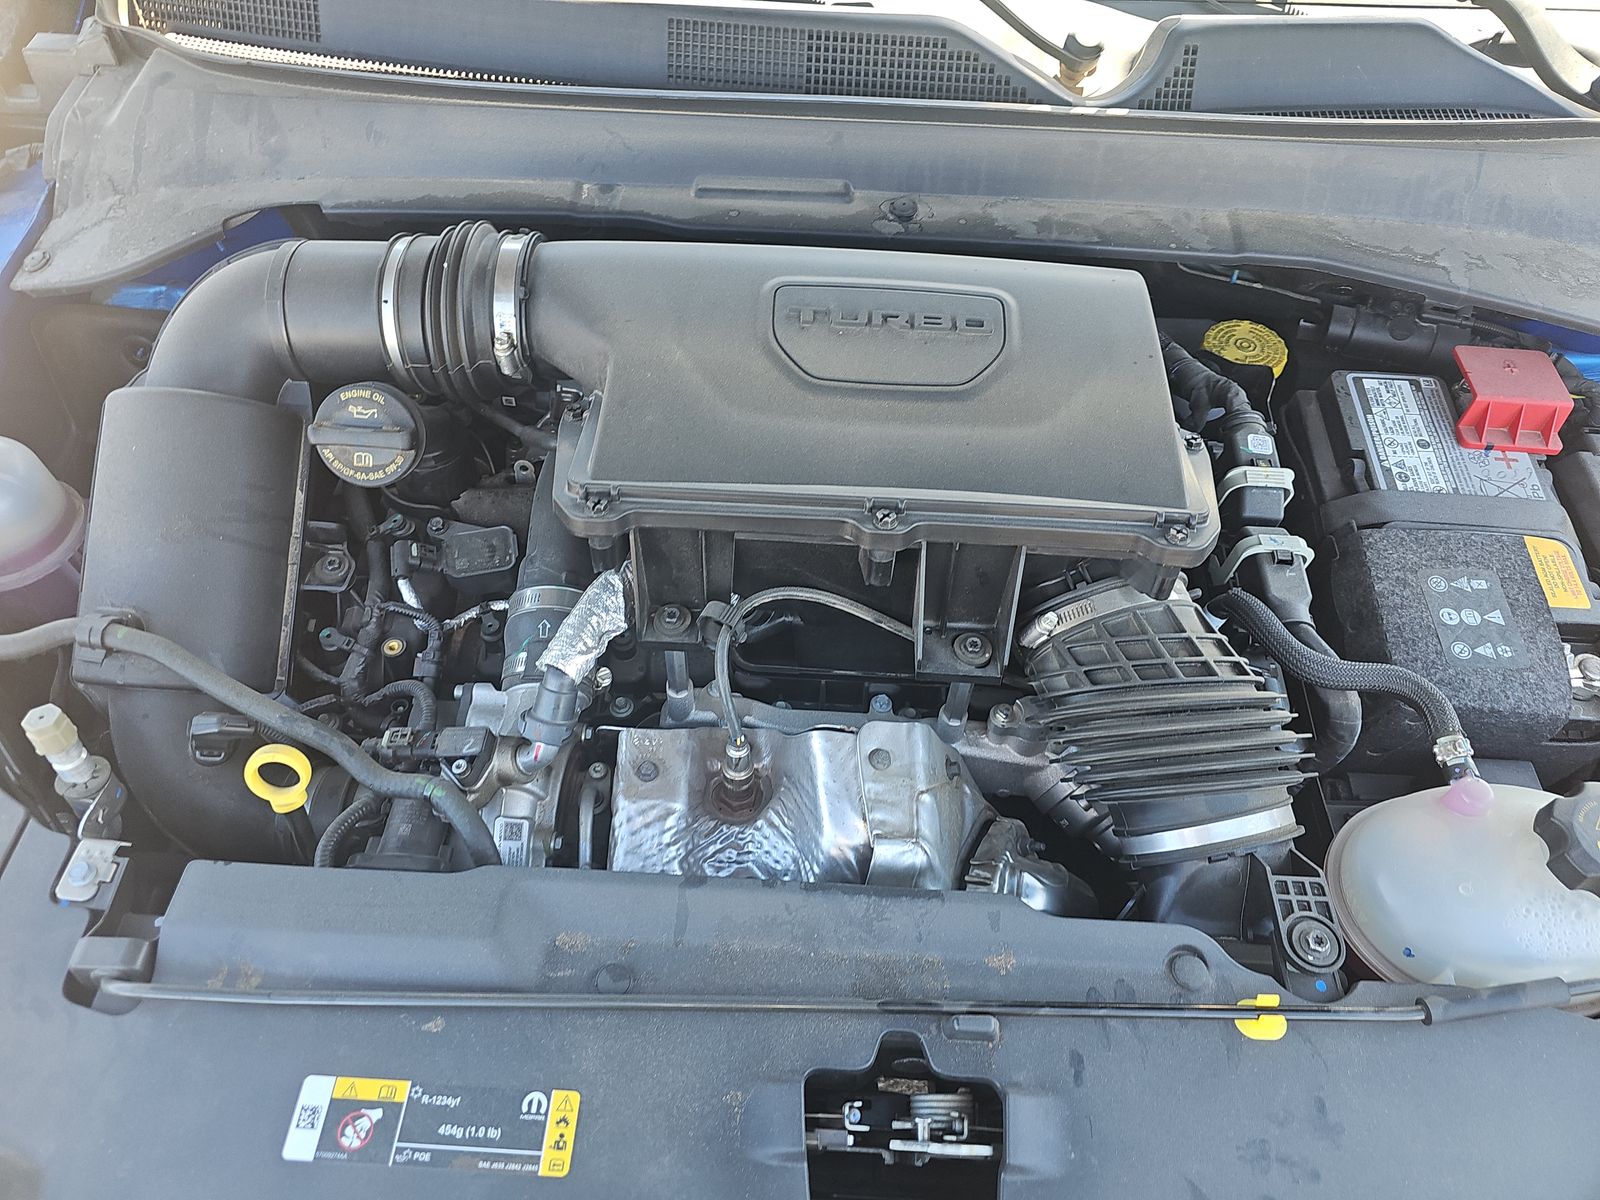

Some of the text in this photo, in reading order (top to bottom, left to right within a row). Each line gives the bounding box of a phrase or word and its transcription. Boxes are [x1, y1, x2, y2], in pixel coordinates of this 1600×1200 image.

[787, 305, 994, 335] TURBO
[340, 389, 385, 405] ENGINE OIL
[321, 448, 333, 464] API
[1529, 484, 1543, 499] Pb
[421, 1094, 462, 1108] R-1234yf
[437, 1123, 502, 1141] 454g (1.0 lb)
[413, 1151, 432, 1162] POE
